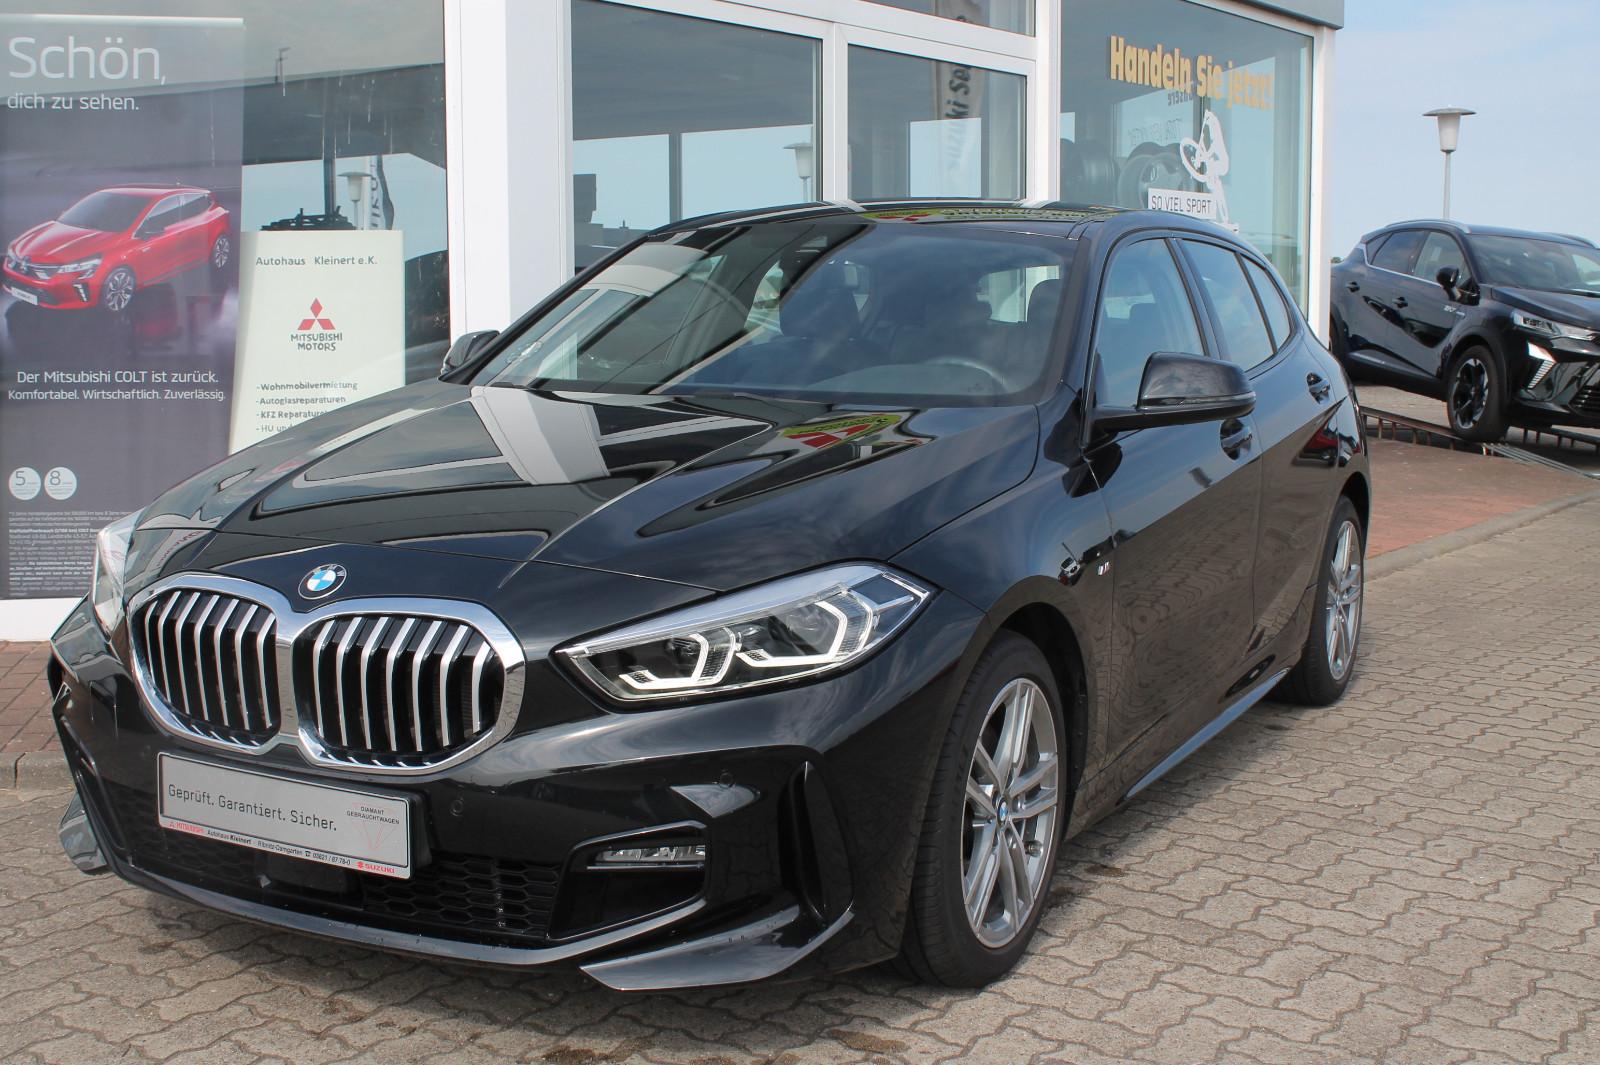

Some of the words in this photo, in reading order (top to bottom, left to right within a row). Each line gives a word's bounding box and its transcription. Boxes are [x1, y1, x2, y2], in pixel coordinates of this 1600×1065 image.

[9, 35, 166, 86] Schön,
[1110, 35, 1192, 94] Handeln
[1196, 55, 1223, 101] Sie
[7, 93, 45, 109] dich
[51, 96, 73, 110] zu
[79, 93, 140, 111] sehen.
[1151, 195, 1163, 210] SO
[1165, 196, 1184, 212] VIEL
[1186, 198, 1212, 214] SPORT
[255, 256, 306, 266] Autohaus
[314, 255, 356, 265] Kleinert
[358, 255, 378, 265] e.K.
[290, 332, 343, 342] MITSUBISHI
[297, 342, 337, 352] MOTORS
[17, 371, 41, 384] Der
[44, 370, 111, 383] Mitsubishi
[114, 371, 148, 383] COLT
[151, 371, 168, 383] ist
[171, 370, 219, 384] zurück.
[8, 389, 80, 401] Komfortabel.
[83, 389, 162, 401] Wirtschaftlich.
[164, 389, 226, 402] Zuverlässig.
[15, 470, 26, 486] 5
[50, 470, 61, 486] 8
[168, 784, 215, 806] Geprüft.
[218, 795, 286, 821] Garantiert.
[290, 809, 337, 831] Sicher.
[360, 806, 385, 815] DIAMANT
[346, 810, 400, 825] GEBRAUCHTWAGEN
[230, 834, 252, 845] Kleinert
[364, 863, 396, 874] SUZUKI
